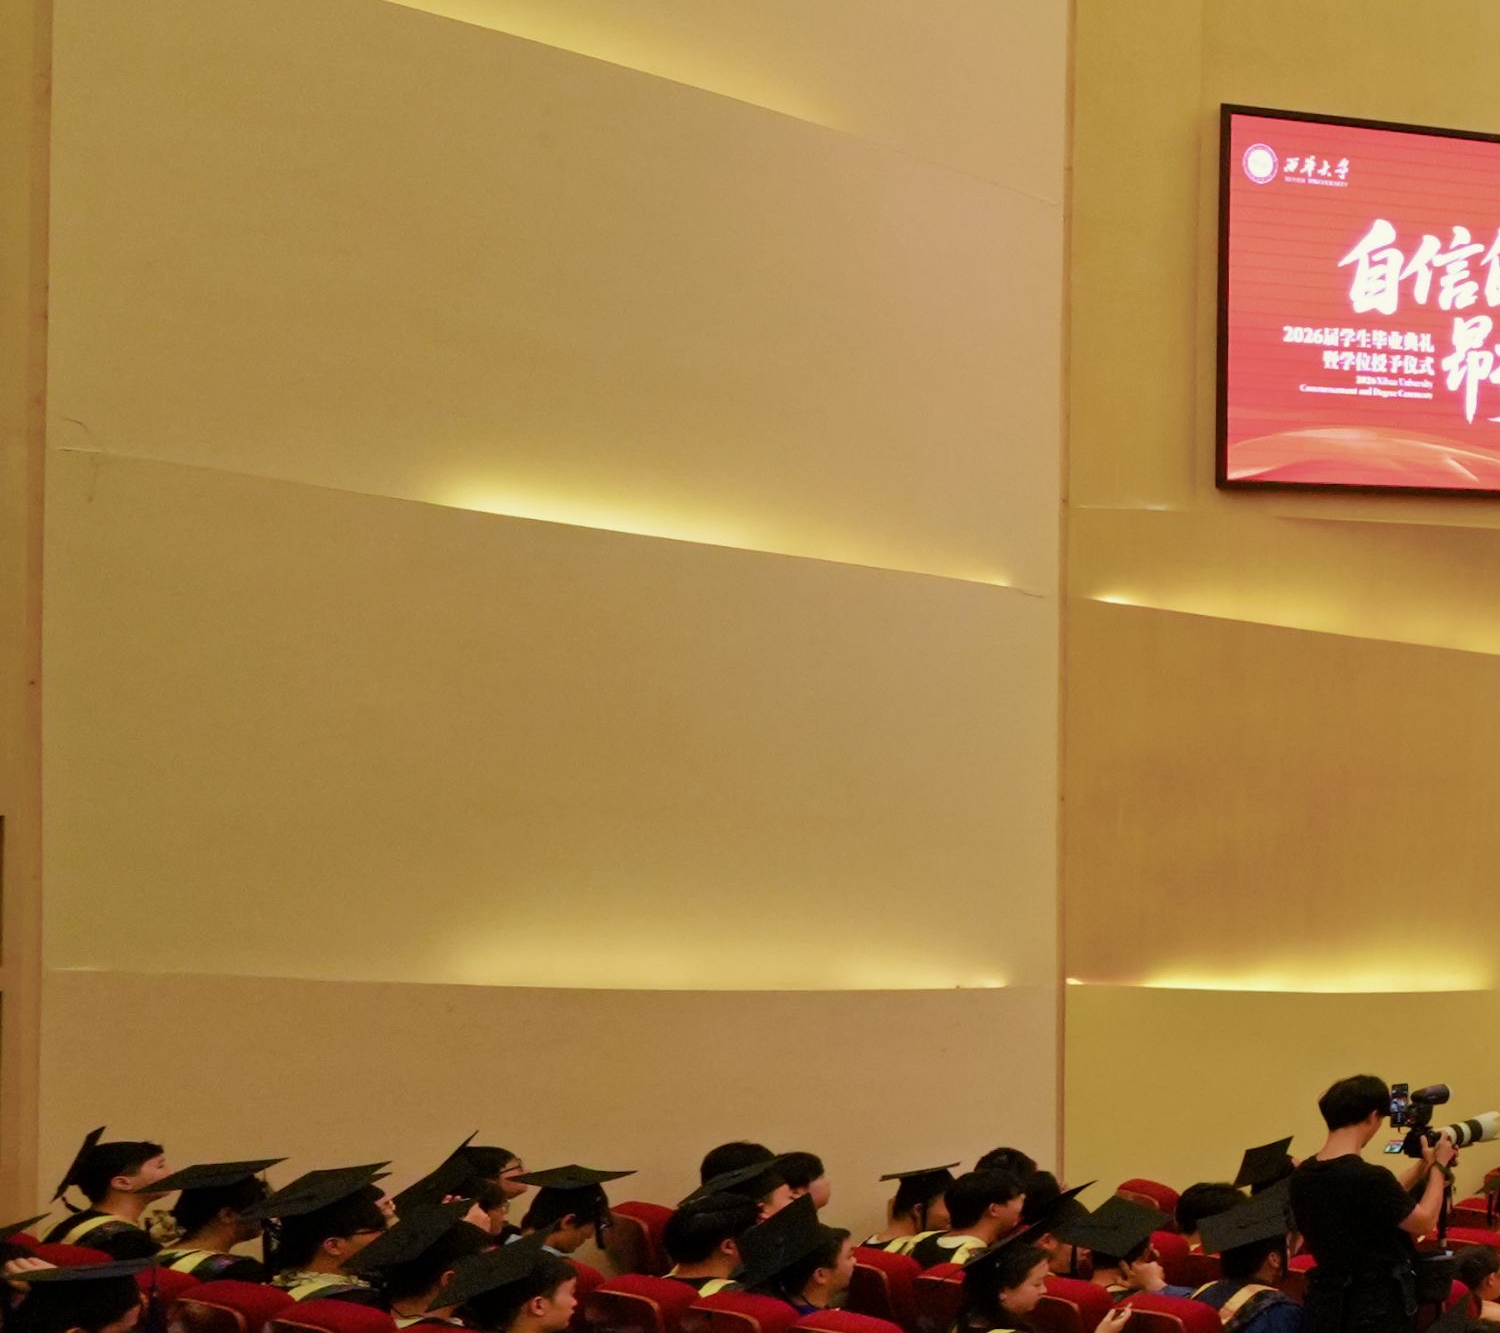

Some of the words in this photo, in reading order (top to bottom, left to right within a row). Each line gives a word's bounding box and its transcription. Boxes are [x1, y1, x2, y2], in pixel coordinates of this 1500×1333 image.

[1282, 325, 1435, 353] 2026届学生毕业典礼
